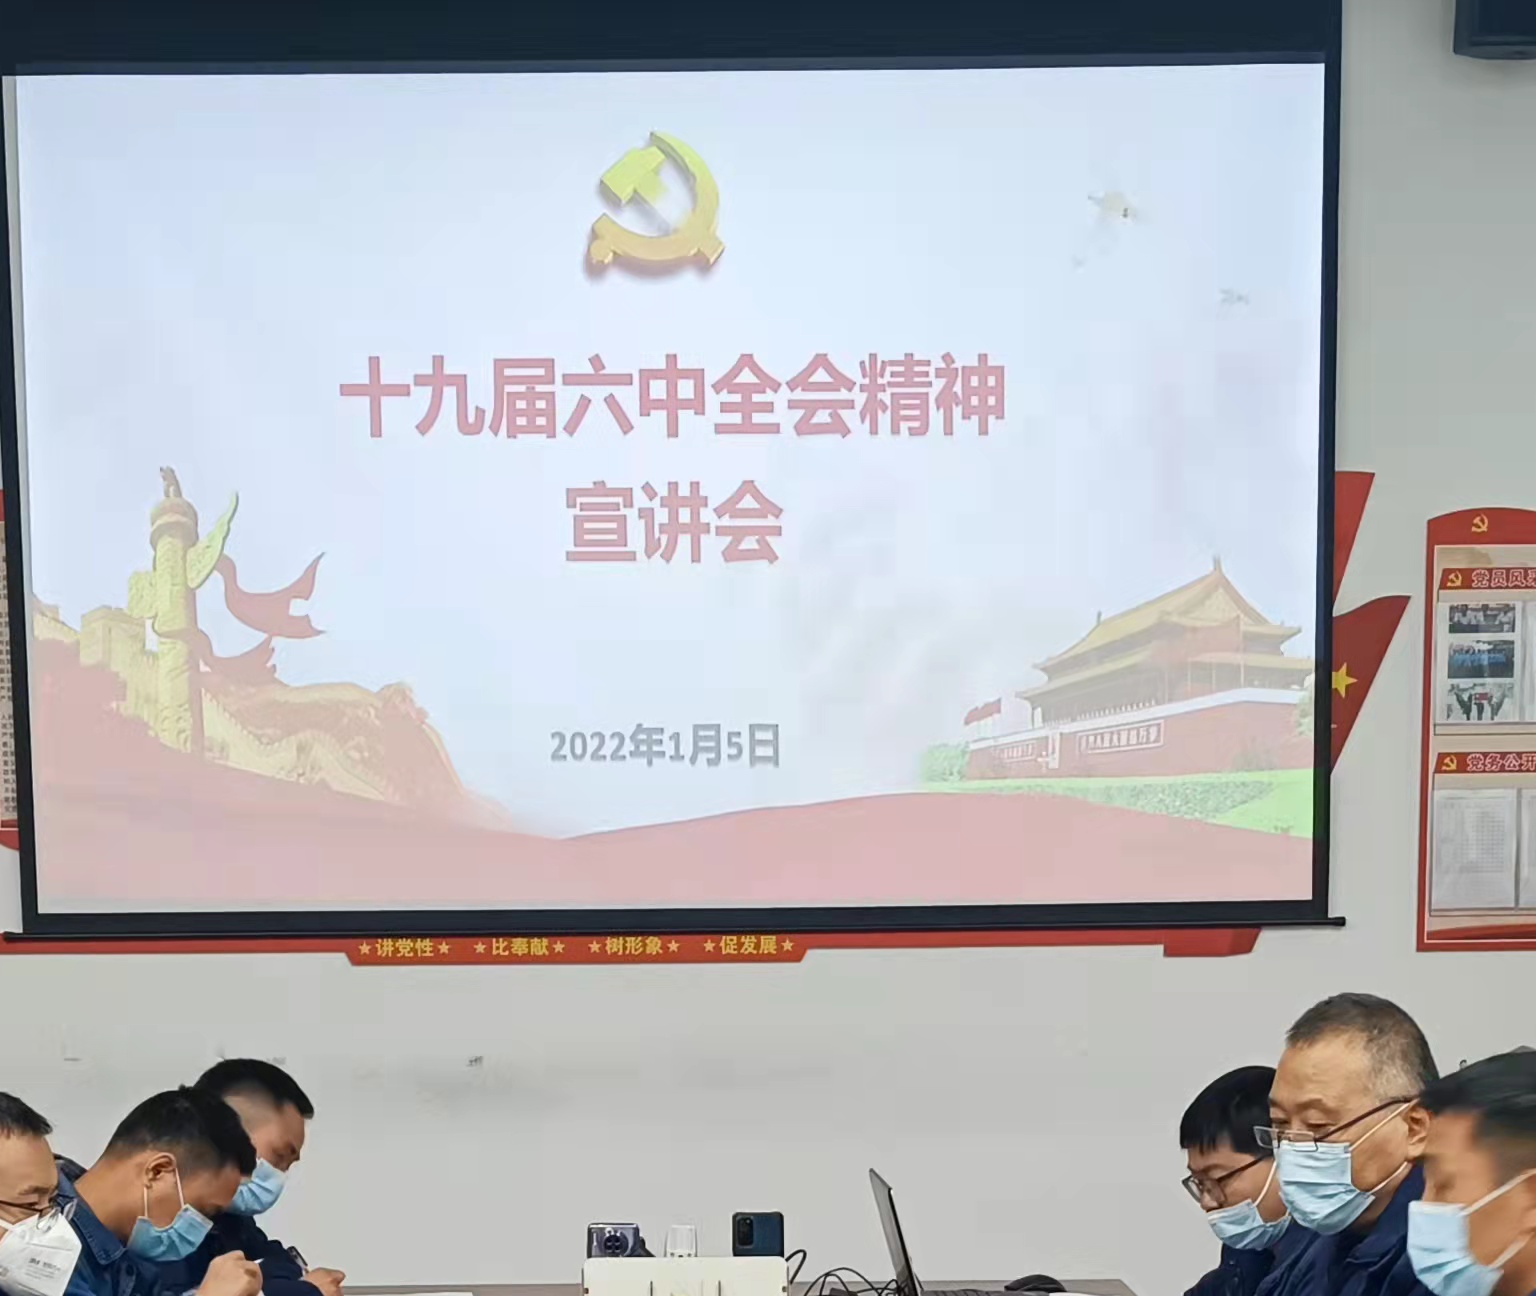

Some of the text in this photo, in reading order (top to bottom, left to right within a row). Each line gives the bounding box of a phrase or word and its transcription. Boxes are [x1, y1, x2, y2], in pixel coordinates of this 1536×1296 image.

[340, 353, 1006, 438] 十九届六中全会精神
[565, 480, 785, 564] 宣讲会
[550, 723, 780, 768] 2022年1月5日
[376, 935, 778, 958] 讲党性 比奉献 树形象 促发展
